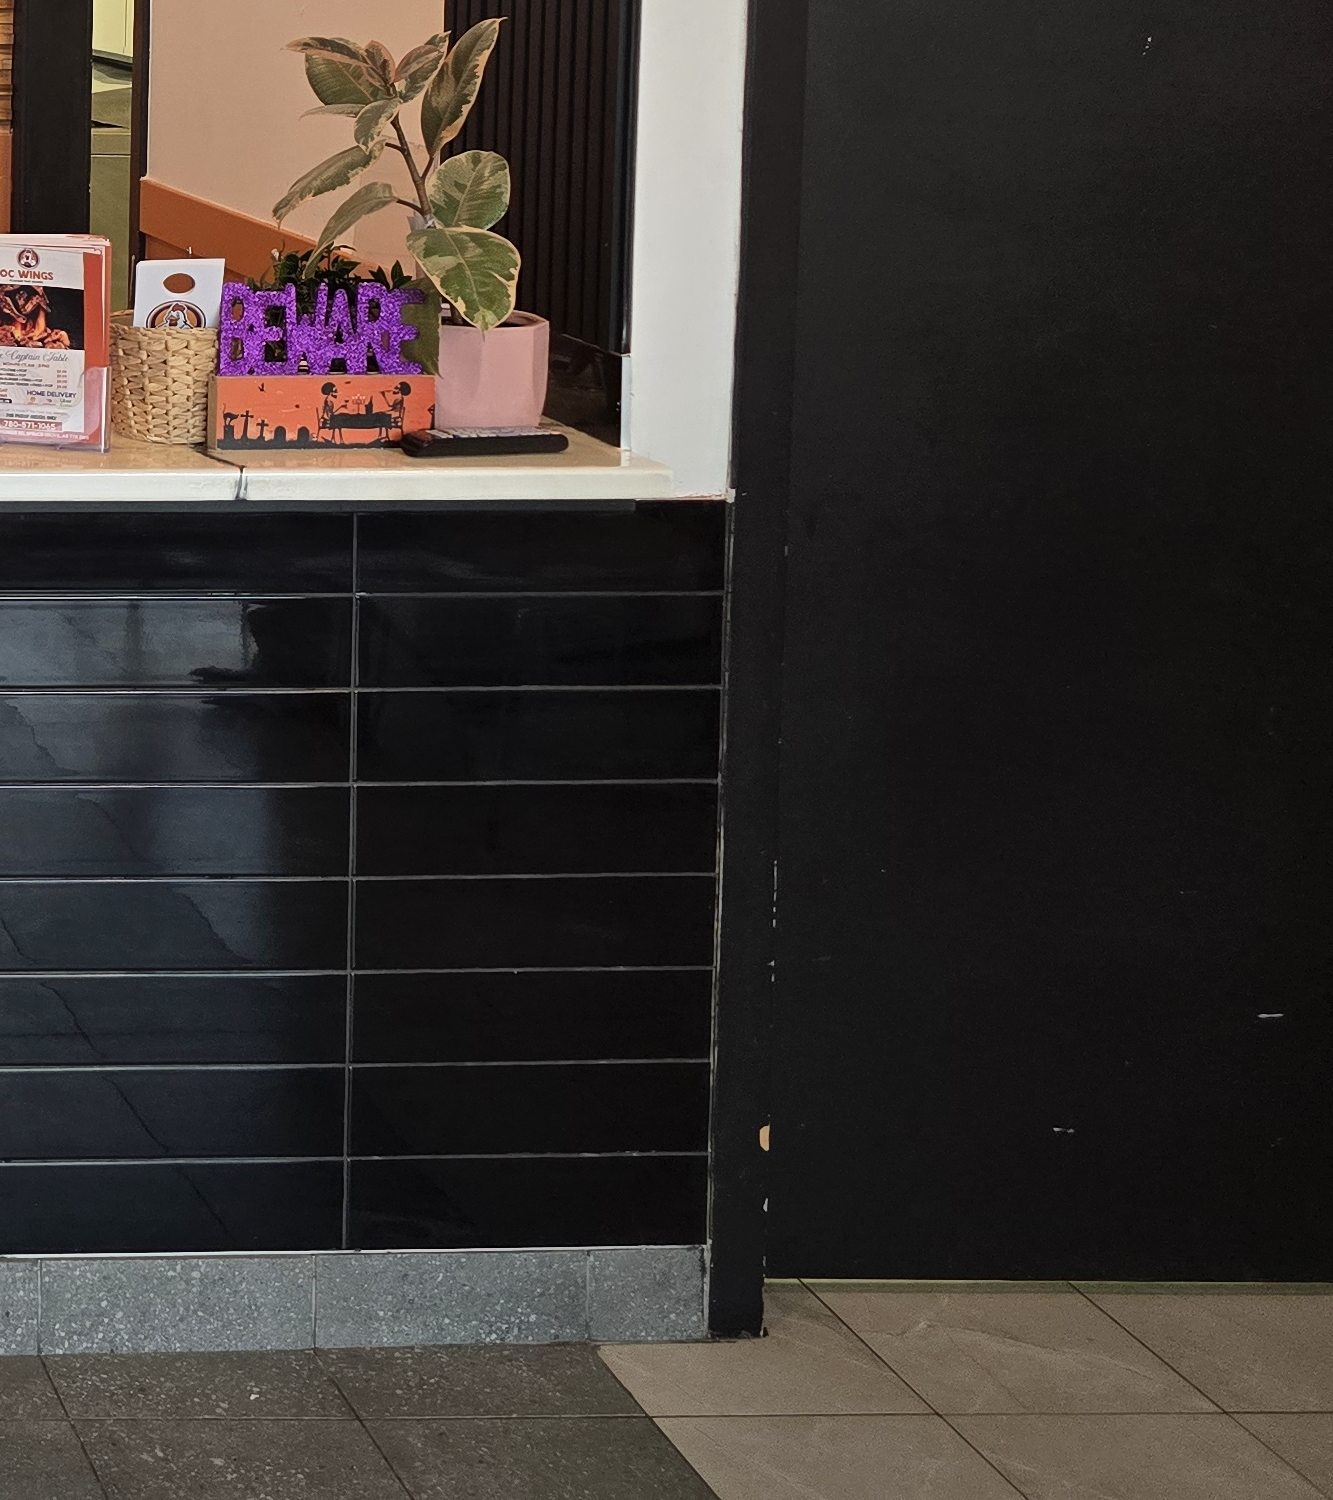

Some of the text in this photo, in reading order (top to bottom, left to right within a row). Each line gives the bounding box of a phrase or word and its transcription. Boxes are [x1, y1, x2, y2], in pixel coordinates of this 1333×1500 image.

[0, 269, 54, 281] OC WINGS
[218, 282, 427, 375] BEWARE
[5, 350, 40, 363] Captain
[43, 351, 69, 362] Table
[26, 389, 77, 399] HOME DELIVERY
